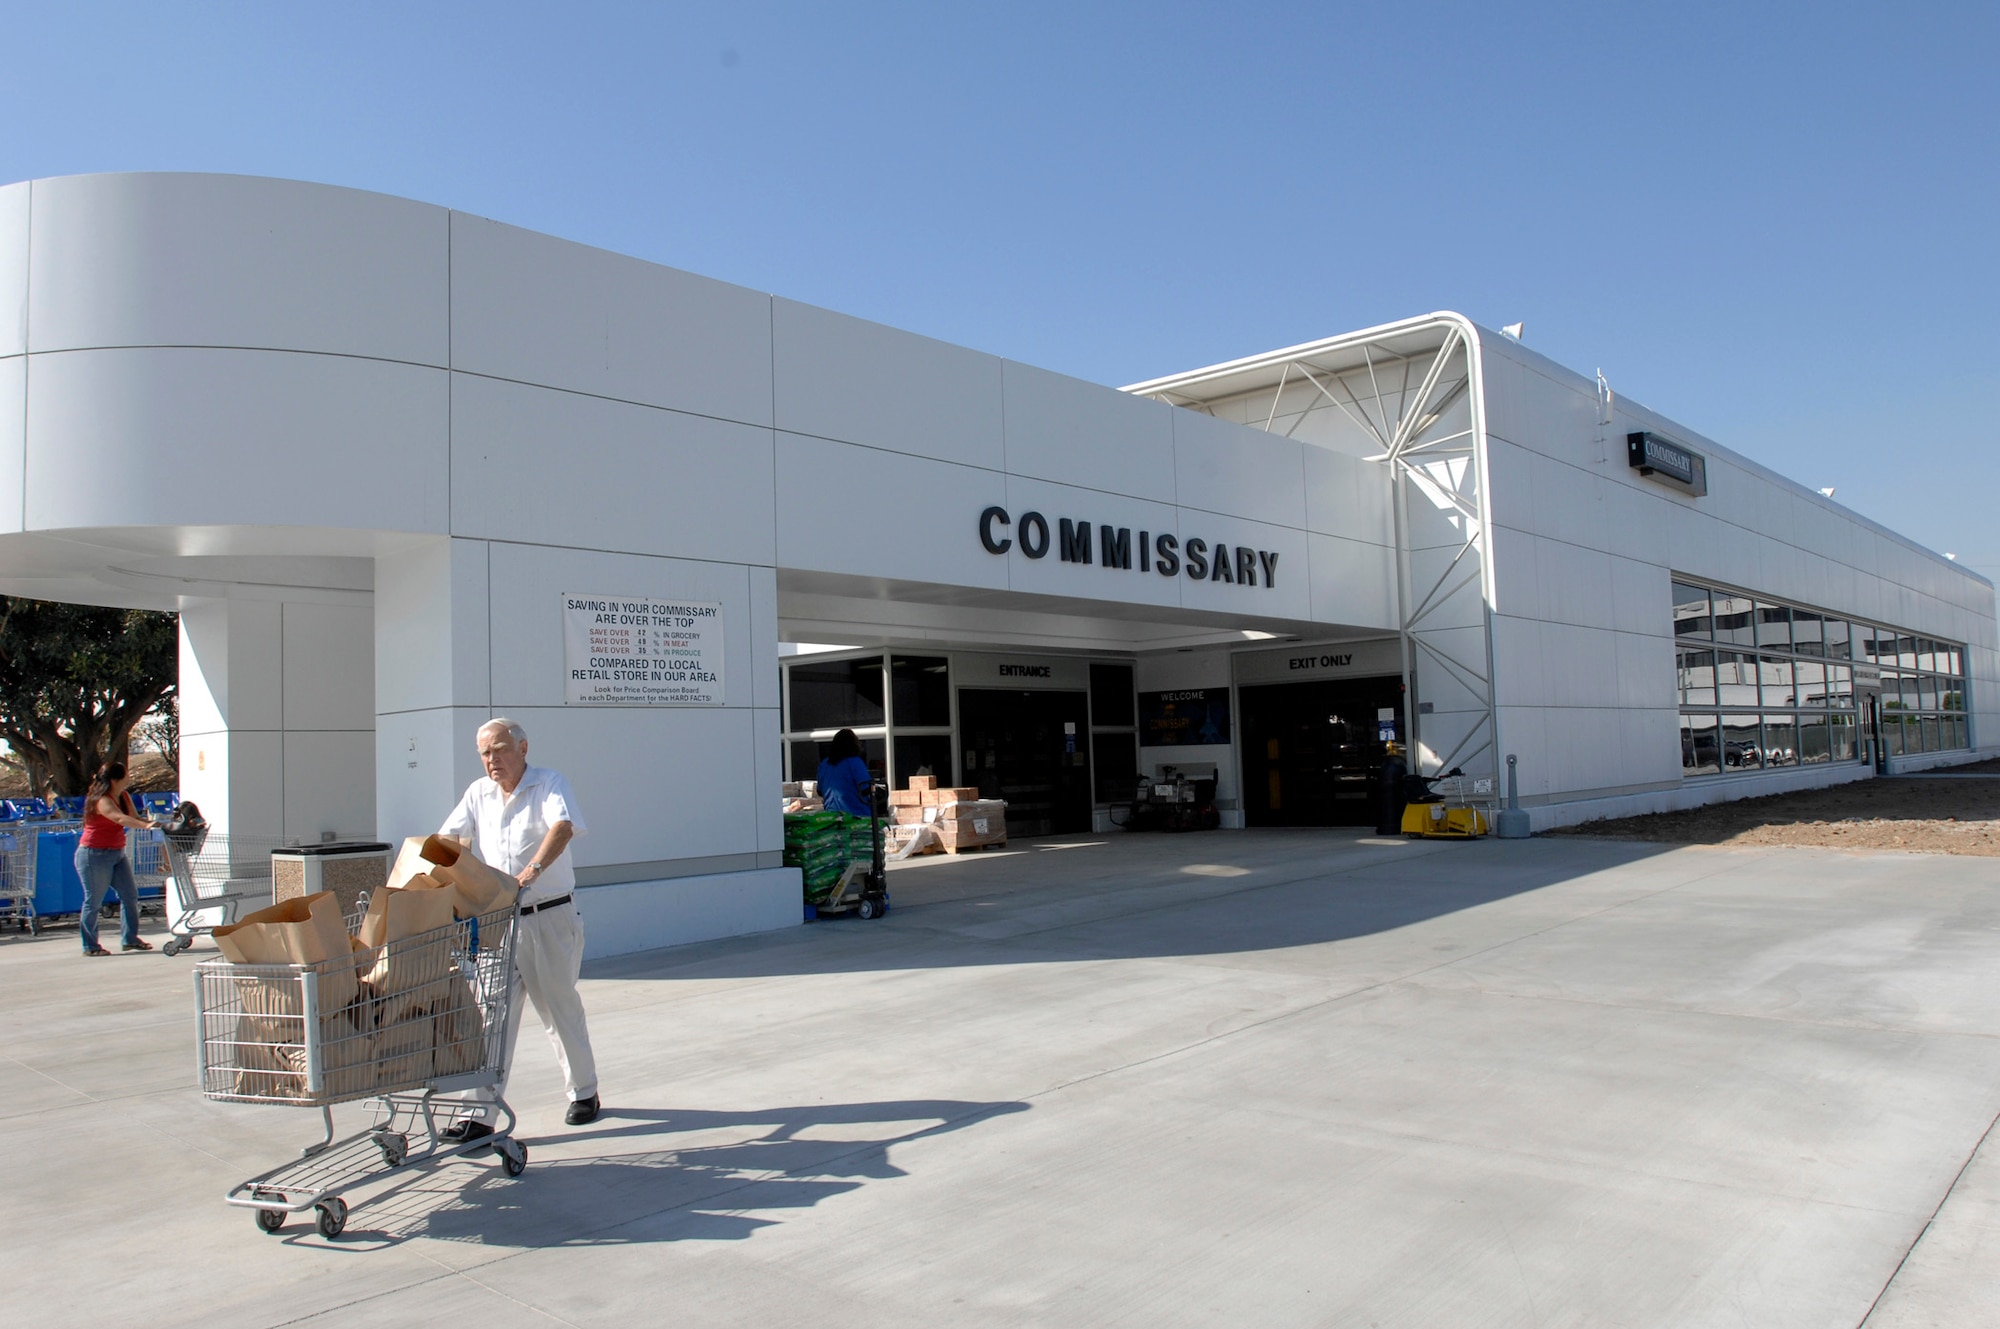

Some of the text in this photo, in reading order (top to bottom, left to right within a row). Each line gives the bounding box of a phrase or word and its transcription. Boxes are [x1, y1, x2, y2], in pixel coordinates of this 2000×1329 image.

[1645, 440, 1690, 472] COMMISSARY
[979, 506, 1279, 588] COMMISSARY
[568, 600, 717, 617] SAVING IN YOUR COMMISSARY
[595, 614, 694, 628] ARE OVER THE TOP
[590, 658, 702, 670] COMPARED TO LOCAL
[1289, 654, 1353, 670] EXIT ONLY
[572, 670, 716, 682] RETAIL STORE IN OUR AREA
[999, 664, 1051, 678] ENTRANCE
[1160, 690, 1205, 702] WELCOME
